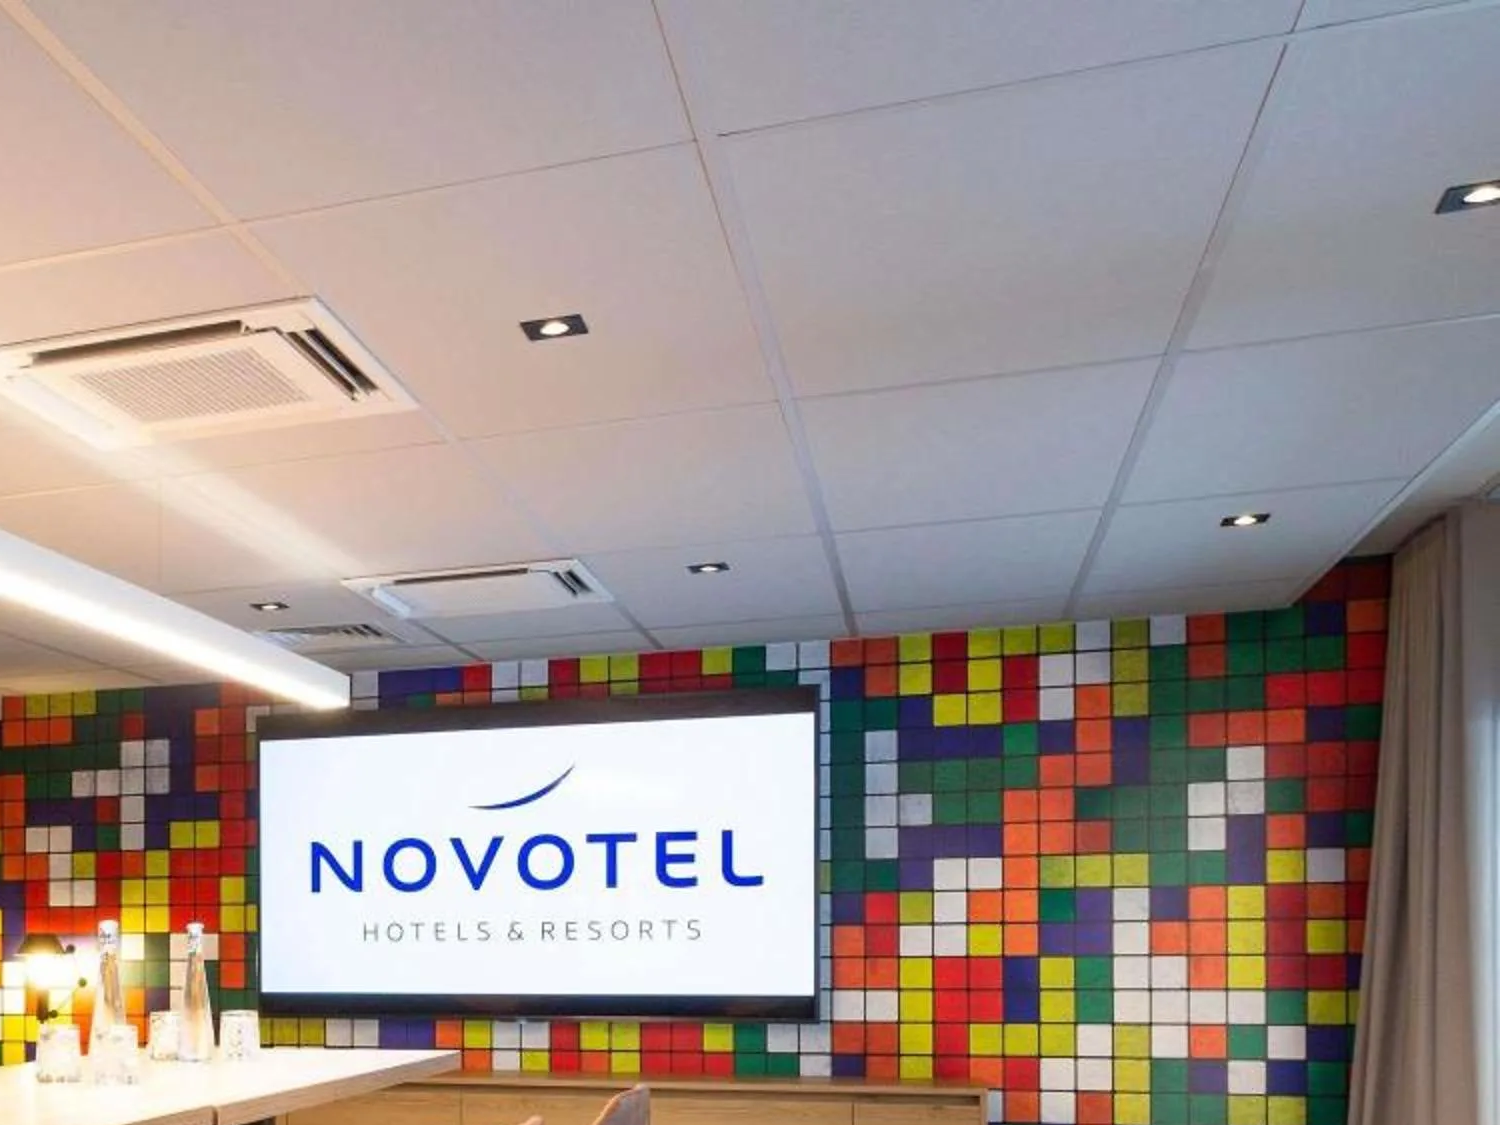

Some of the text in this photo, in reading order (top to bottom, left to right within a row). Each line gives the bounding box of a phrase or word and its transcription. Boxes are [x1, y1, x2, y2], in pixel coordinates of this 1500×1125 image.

[309, 829, 765, 893] NOVOTEL
[362, 919, 702, 943] HOTELS & RESORTS
